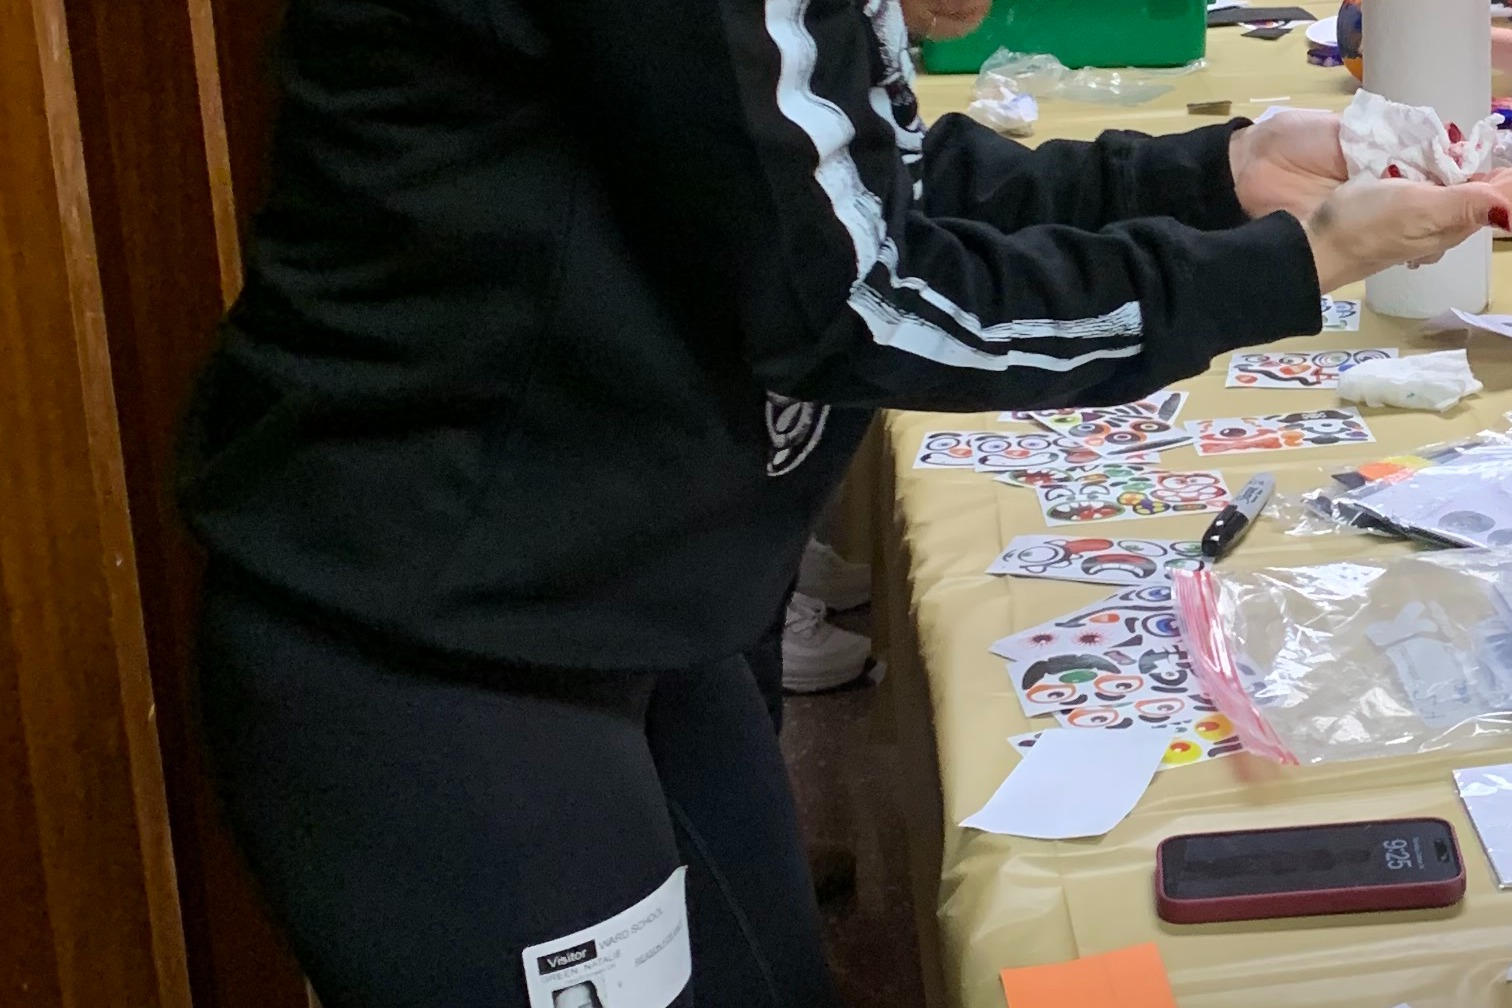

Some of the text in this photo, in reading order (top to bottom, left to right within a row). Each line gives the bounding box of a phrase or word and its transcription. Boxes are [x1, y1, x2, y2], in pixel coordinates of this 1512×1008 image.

[1382, 838, 1412, 870] 9:25
[547, 948, 587, 968] Visitor
[583, 949, 622, 971] NATALIE
